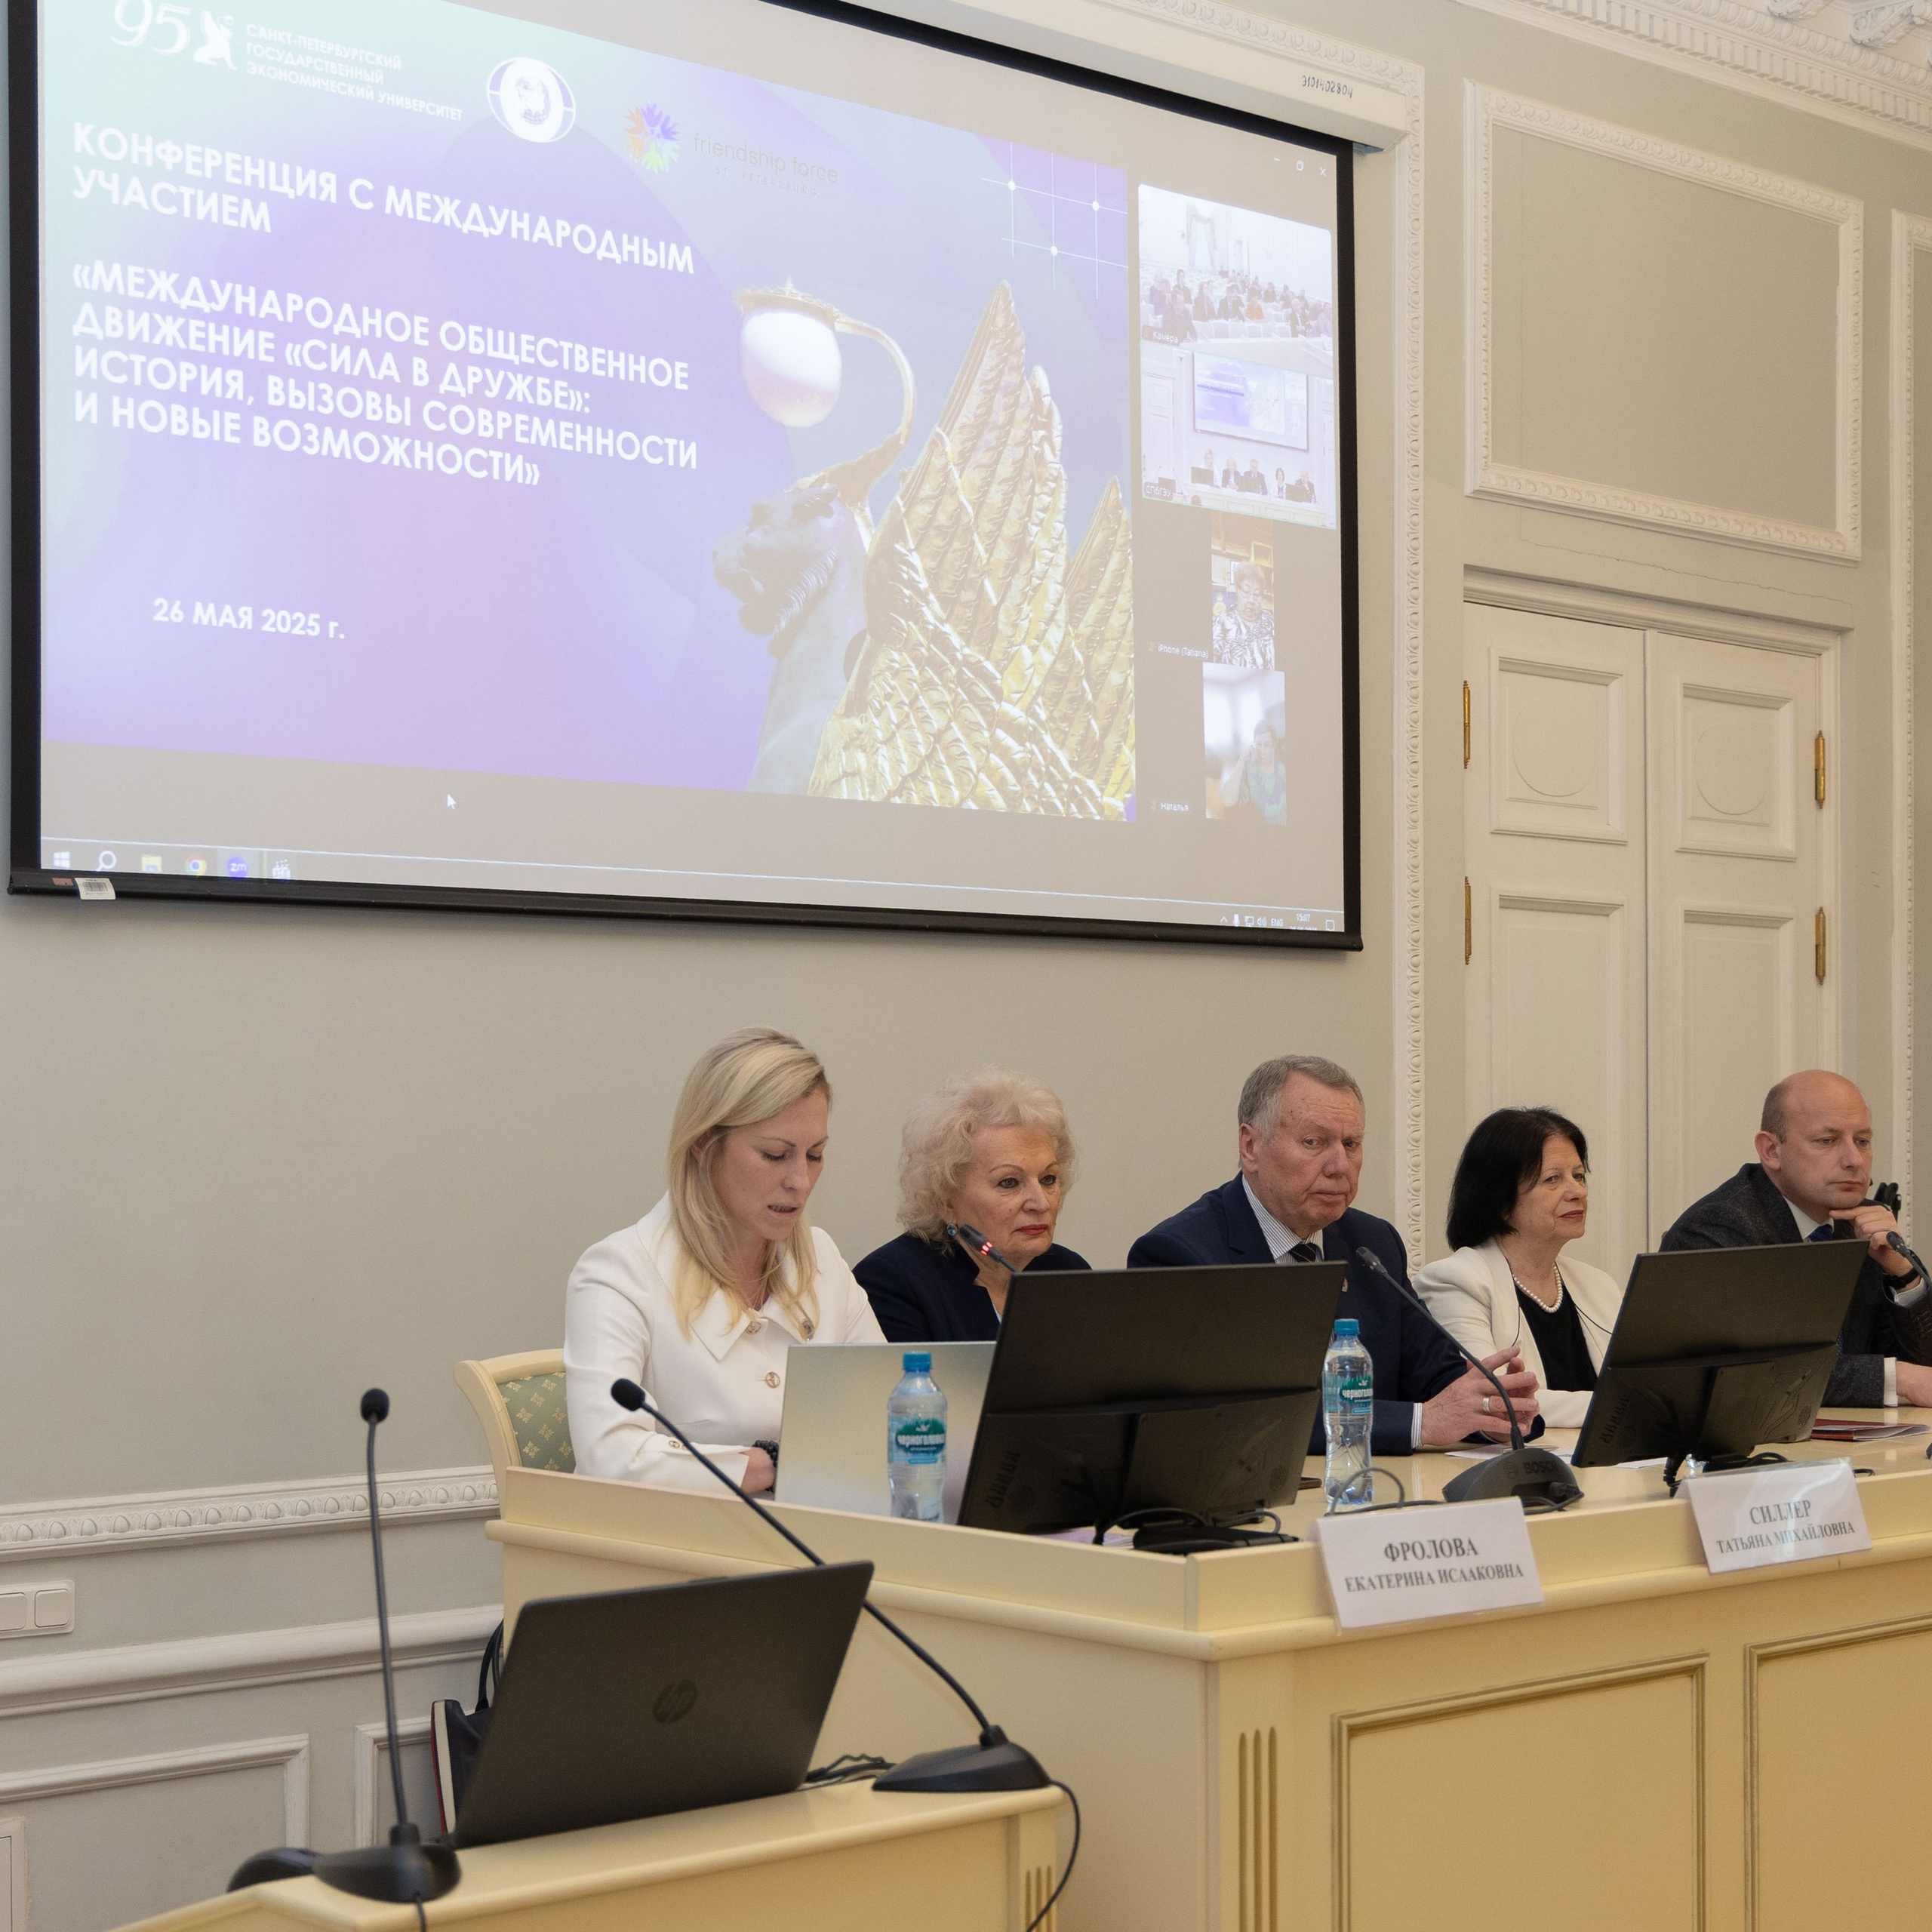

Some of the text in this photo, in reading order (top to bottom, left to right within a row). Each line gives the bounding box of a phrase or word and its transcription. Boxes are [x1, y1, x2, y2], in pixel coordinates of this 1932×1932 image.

[110, 0, 191, 56] 95
[245, 23, 402, 71] САНКТ-ПЕТЕРБУРГСКИЙ
[245, 42, 384, 86] ГОСУДАРСТВЕННЫЙ
[246, 62, 463, 122] ЭКОНОМИЧЕСКИЙ УНИВЕРСИТЕТ
[693, 132, 839, 183] friendship force
[72, 164, 273, 234] УЧАСТИЕМ
[74, 121, 695, 275] КОНФЕРЕНЦИЯ С МЕЖДУНАРОДНЫМ
[72, 259, 690, 391] «МЕЖДУНАРОДНОЕ ОБЩЕСТВЕННОЕ
[1153, 331, 1179, 343] Камера
[72, 301, 592, 416] ДВИЖЕНИЕ «СИЛА В ДРУЖБЕ»:
[75, 345, 698, 470] ИСТОРИЯ, ВЫЗОВЫ СОВРЕМЕННОСТИ
[75, 390, 540, 486] И НОВЫЕ ВОЗМОЖНОСТИ»
[152, 597, 346, 640] 26 МАЯ 2025 г.
[1158, 643, 1180, 655] iPhone
[1161, 801, 1189, 812] Наталья
[1271, 918, 1284, 928] ENG
[1749, 1500, 1811, 1525] СИЛЛЕР
[1384, 1537, 1479, 1563] ФРОЛОВА
[1716, 1521, 1856, 1555] ТАТЬЯНА МИХАЙЛОВНА
[1344, 1563, 1524, 1593] ЕКАТЕРИНА ИСААКОВНА
